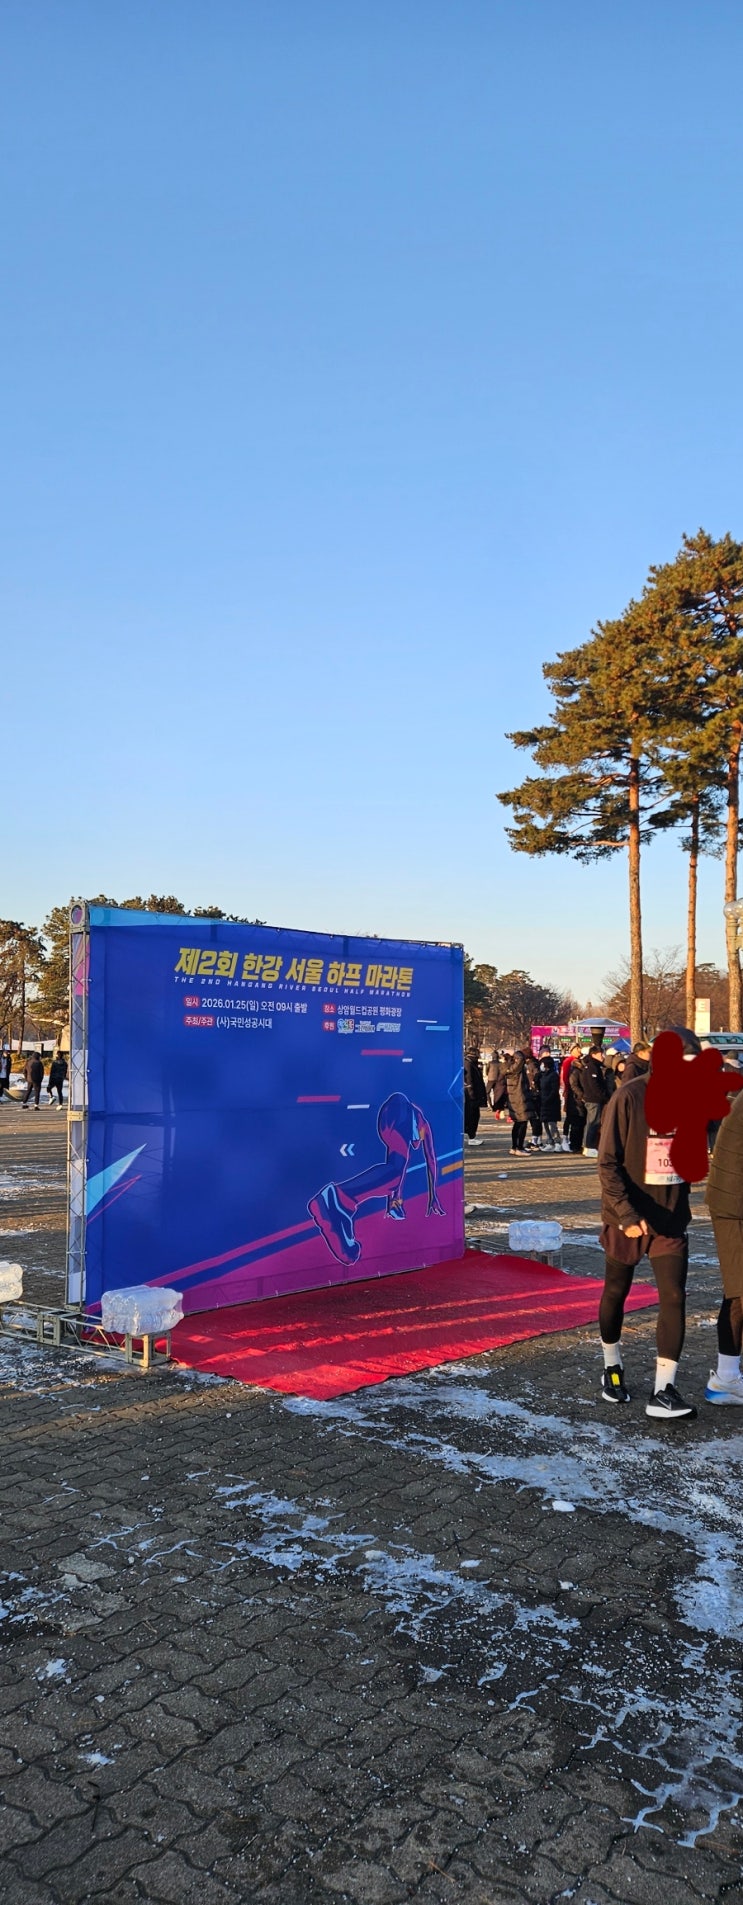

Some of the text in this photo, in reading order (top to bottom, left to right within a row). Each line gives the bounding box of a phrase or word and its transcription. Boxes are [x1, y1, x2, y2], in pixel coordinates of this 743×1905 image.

[174, 947, 414, 991] 제2회 한강 서울 하프 마라톤
[174, 976, 194, 984] THE
[226, 980, 273, 989] HANGANG
[278, 983, 306, 992] RIVER
[312, 986, 339, 994] SEOUL
[369, 989, 411, 998] MARATHON
[185, 997, 308, 1014] 일시 2026.01.25(일) 오전 09시 출발
[337, 1005, 379, 1016] 상암월드컵공원
[379, 1006, 402, 1017] 평화광장
[185, 1016, 273, 1029] 주최/주관 (사)국민성공시대
